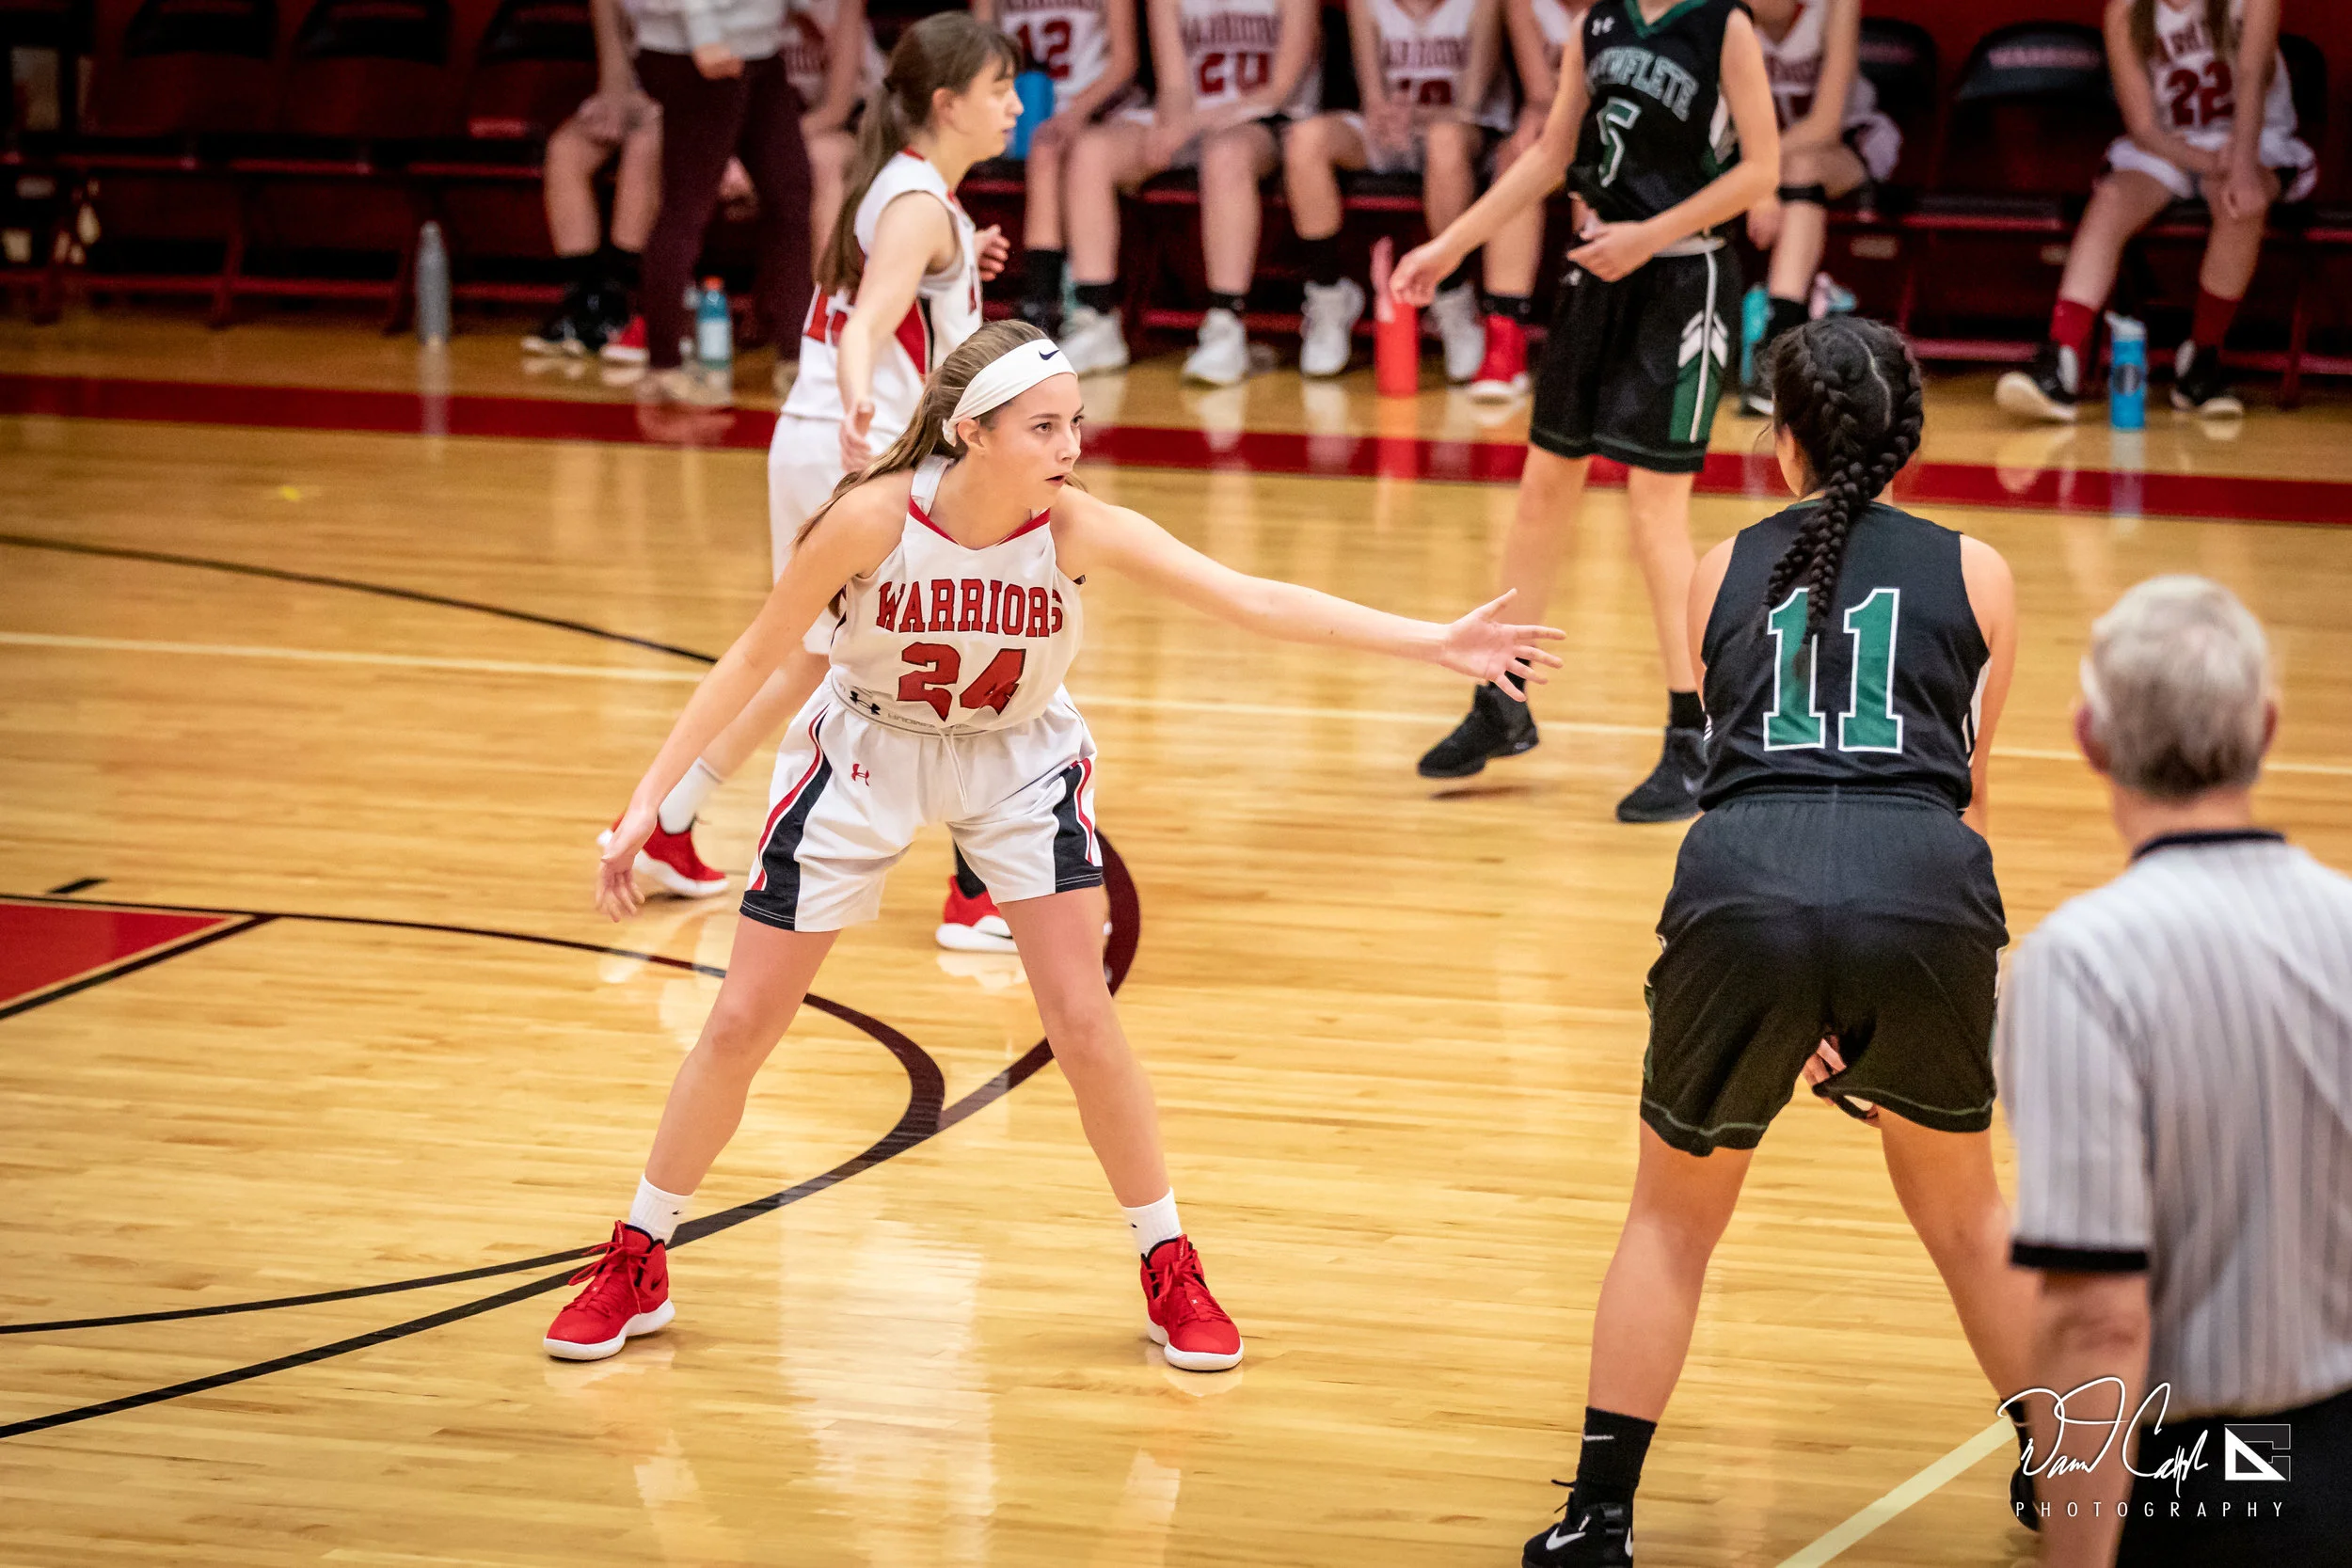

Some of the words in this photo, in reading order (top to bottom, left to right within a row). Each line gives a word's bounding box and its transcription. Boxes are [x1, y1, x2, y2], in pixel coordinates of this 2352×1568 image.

[1017, 21, 1073, 79] 12
[2167, 61, 2235, 126] 22
[1597, 97, 1642, 187] 5
[876, 578, 1063, 638] WARRIORS
[897, 641, 1026, 722] 24
[1763, 587, 1903, 753] 11
